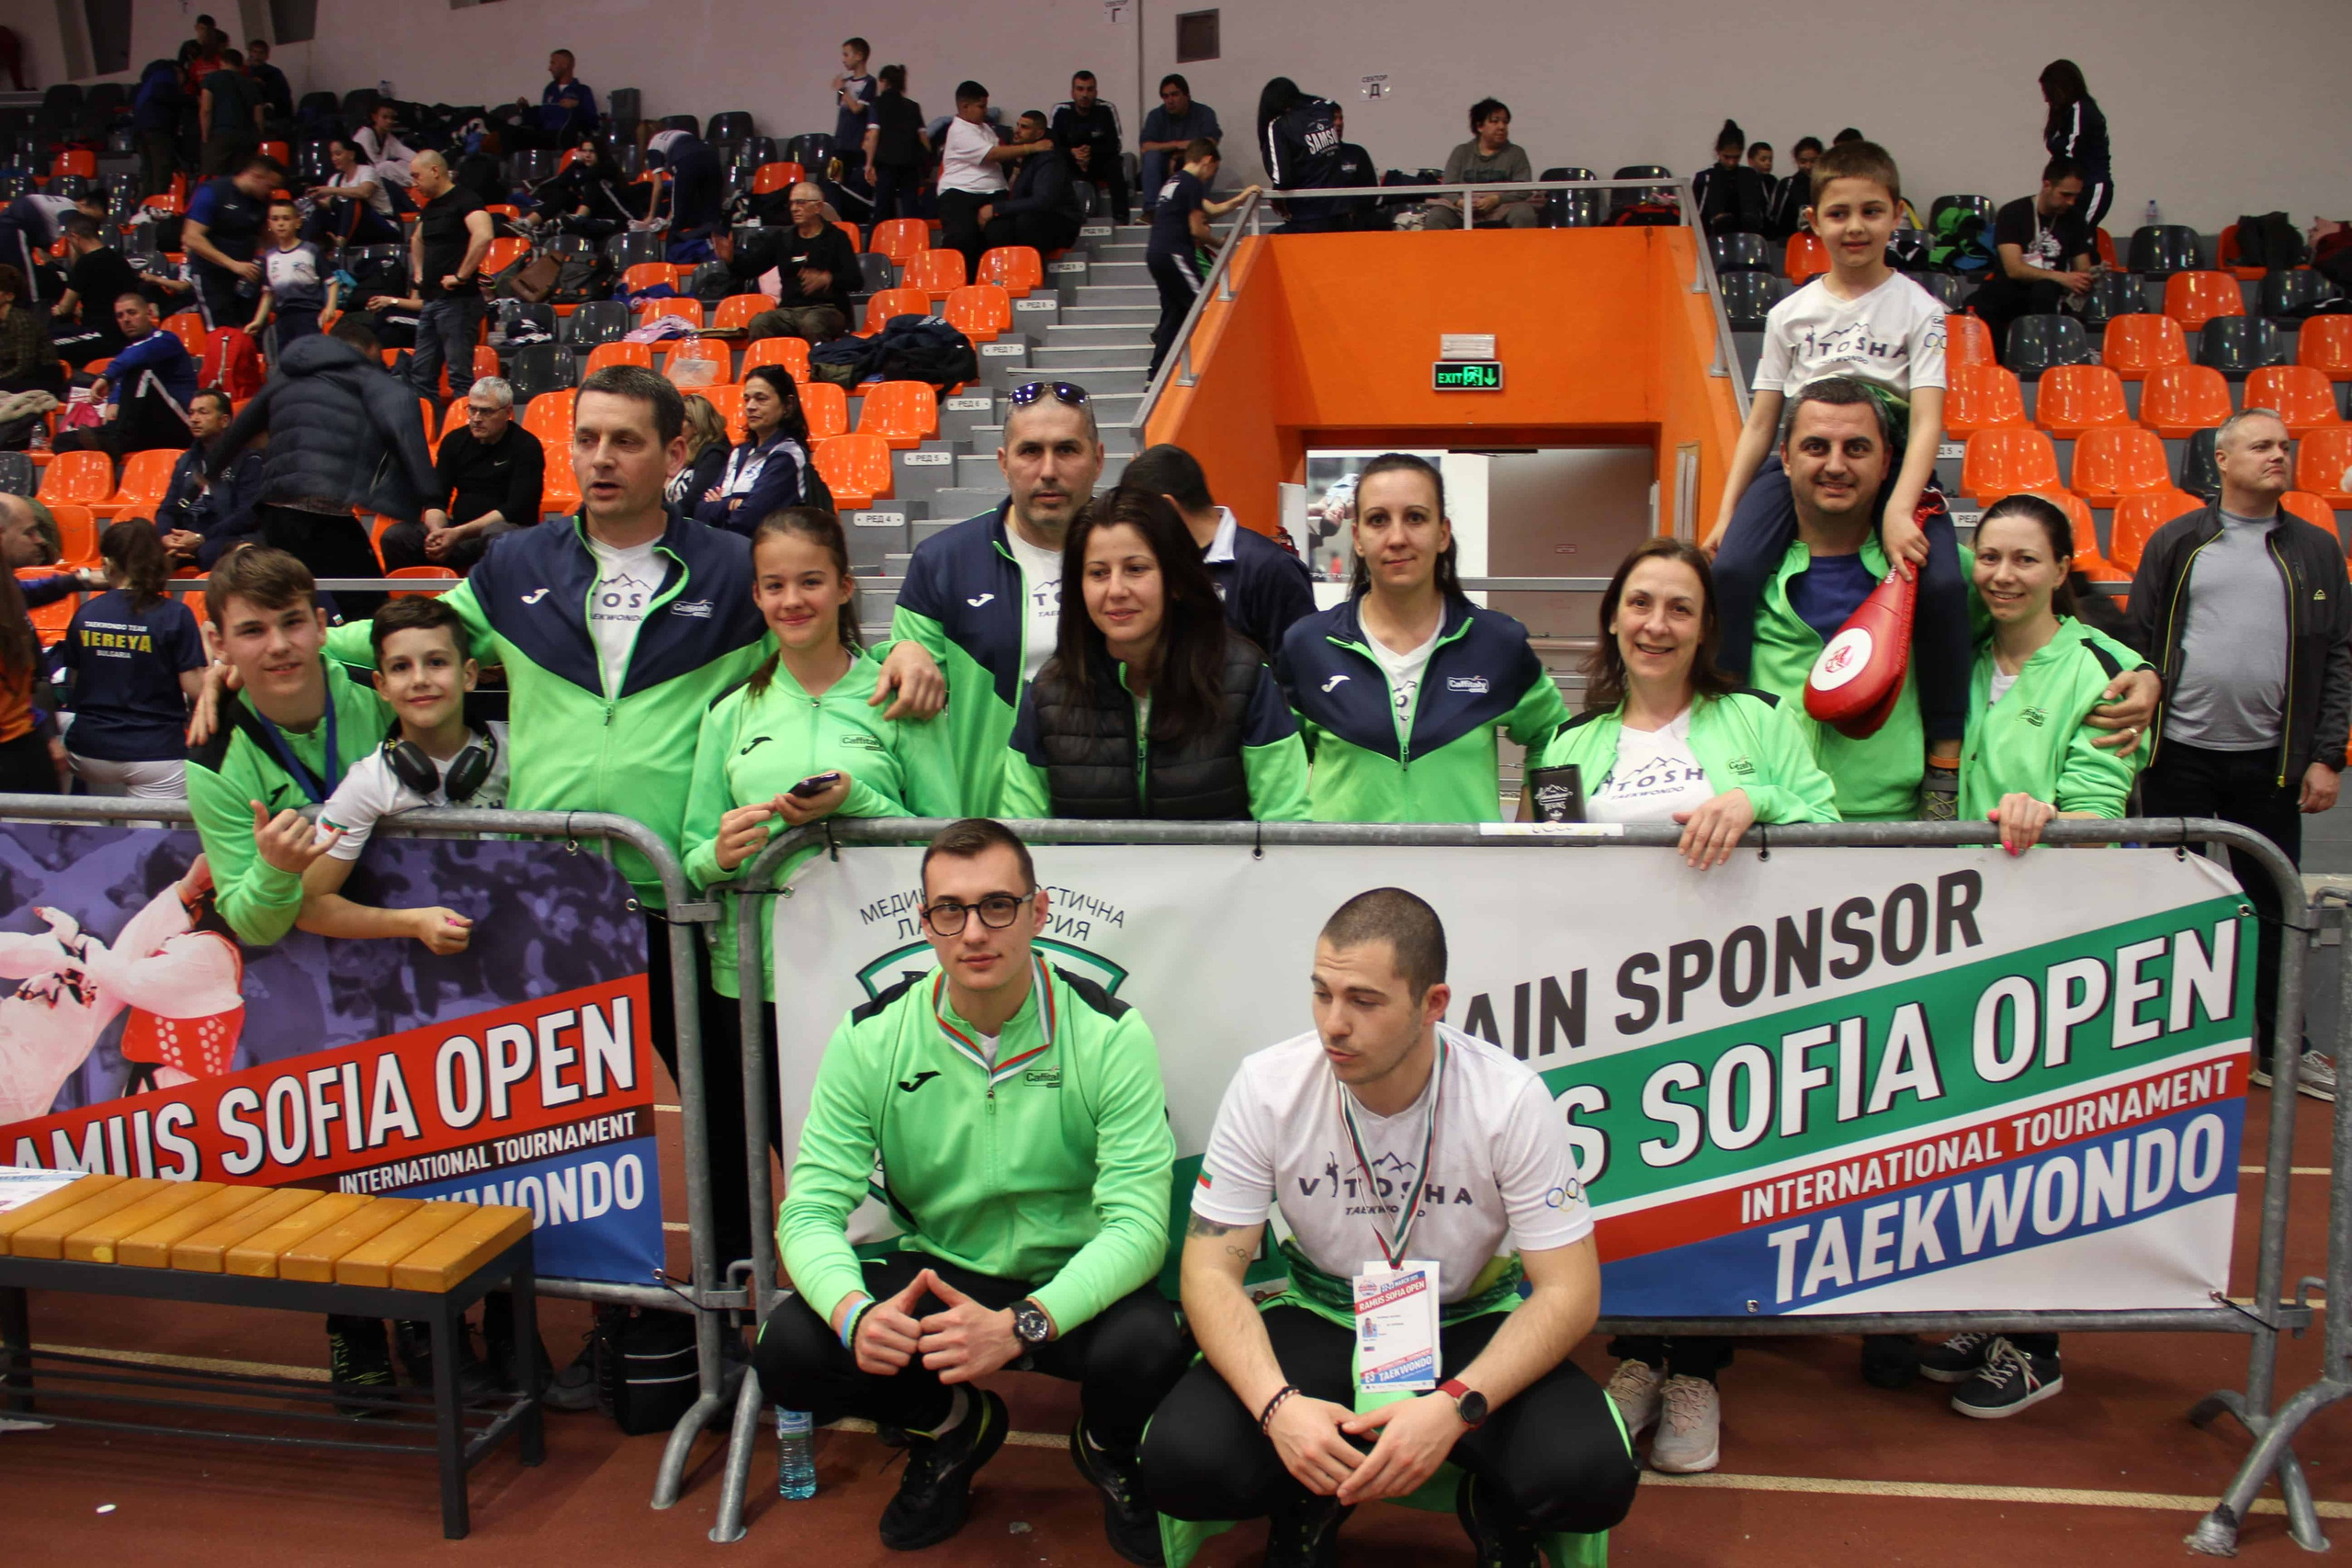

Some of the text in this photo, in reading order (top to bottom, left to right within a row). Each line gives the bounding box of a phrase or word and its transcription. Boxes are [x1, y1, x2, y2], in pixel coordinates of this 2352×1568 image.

[1113, 7, 1121, 22] Г
[1362, 74, 1388, 83] СЕКТОР
[1369, 84, 1380, 98] Д
[1438, 373, 1463, 383] EXIT
[866, 515, 884, 524] РЕД
[1958, 514, 1978, 524] РЕД
[96, 649, 132, 659] BULGARIA
[1614, 869, 1984, 1035] SPONSOR
[1639, 1001, 1946, 1170] SOFIA
[1972, 917, 2240, 1084] OPEN
[217, 1052, 423, 1177] SOFIA
[435, 994, 636, 1129] OPEN
[339, 1111, 638, 1195] INTERNATIONAL TOURNAMENT
[1741, 1060, 2233, 1224] INTERNATIONAL TOURNAMENT
[1768, 1111, 2225, 1305] TAEKWONDO
[1359, 1296, 1385, 1312] RAMUS
[1385, 1288, 1406, 1302] SOFIA
[1406, 1280, 1425, 1294] OPEN
[1379, 1355, 1433, 1382] TAEKWONDO
